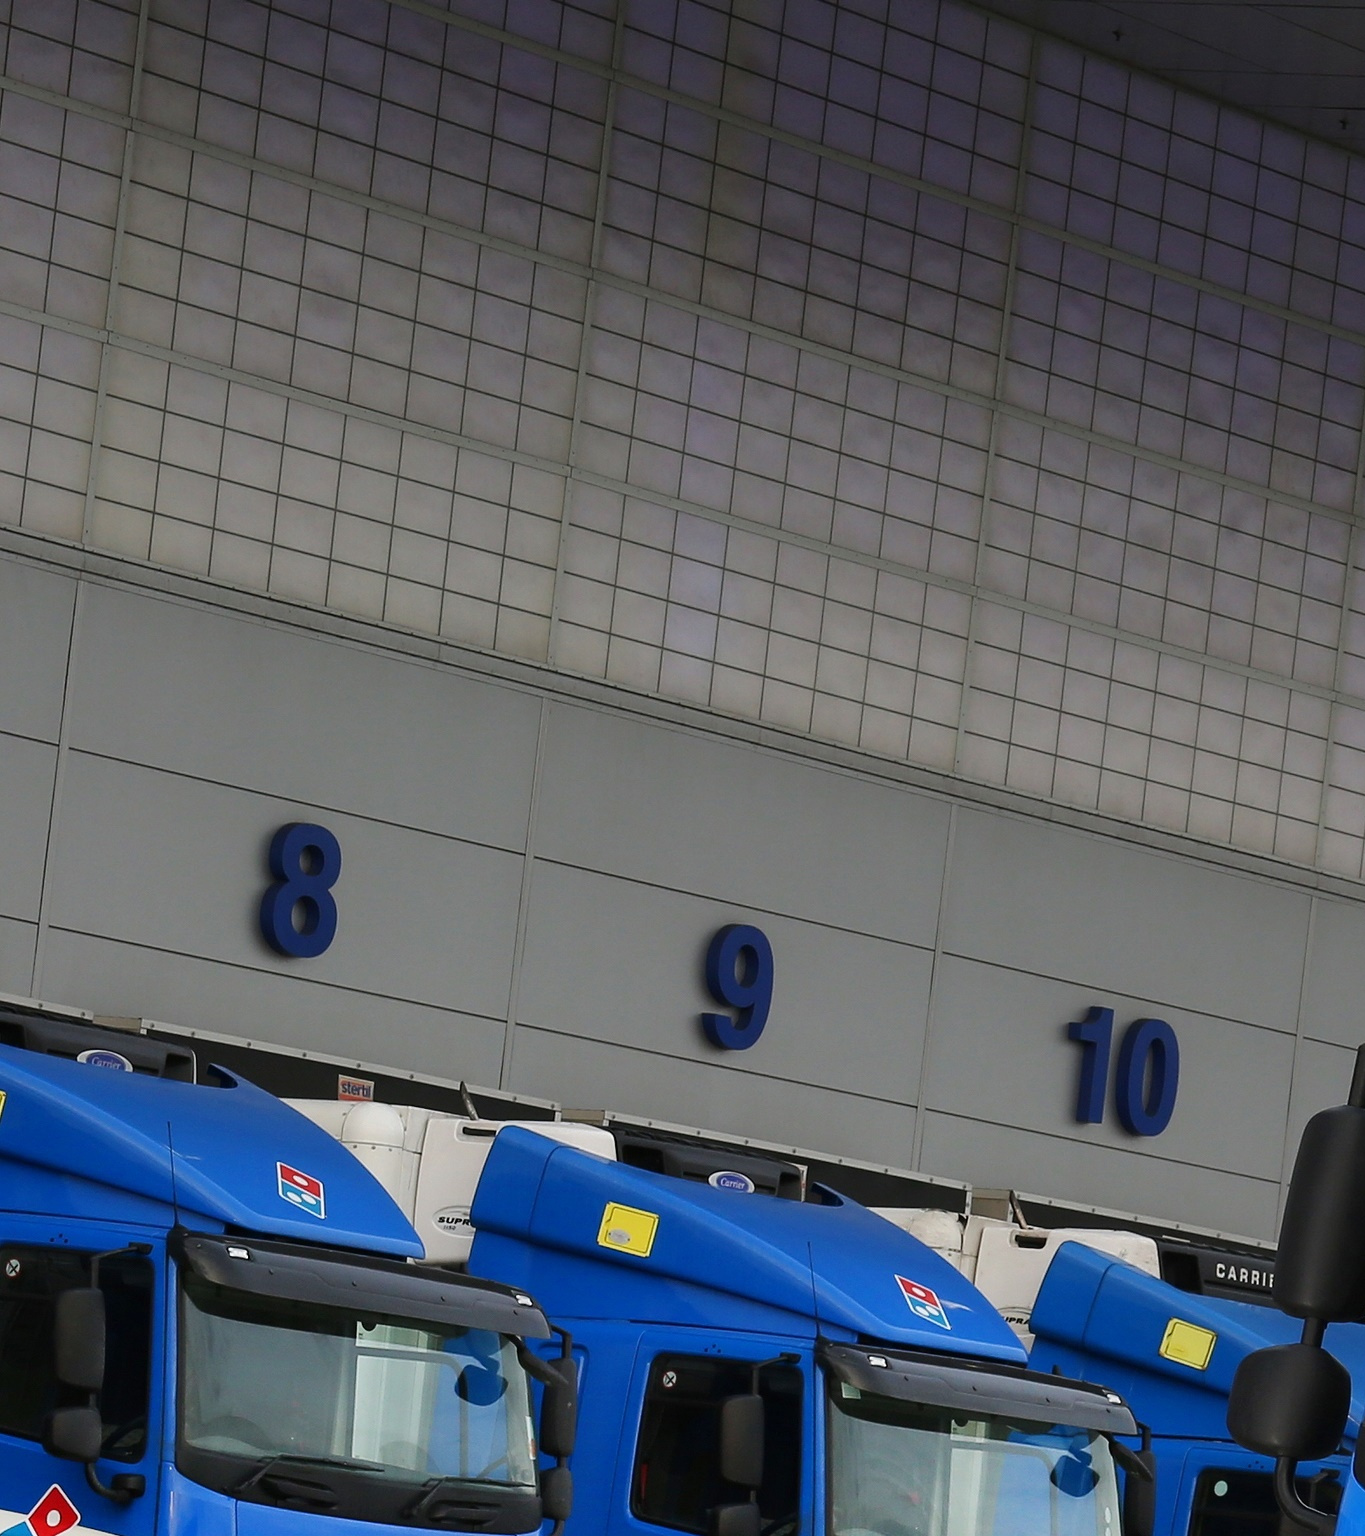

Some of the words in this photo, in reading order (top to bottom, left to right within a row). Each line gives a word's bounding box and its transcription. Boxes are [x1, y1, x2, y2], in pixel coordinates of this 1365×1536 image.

[260, 822, 342, 958] 8
[700, 924, 774, 1051] 9
[341, 1082, 371, 1098] stertil
[1068, 1006, 1180, 1137] 10
[720, 1177, 746, 1190] Carrier
